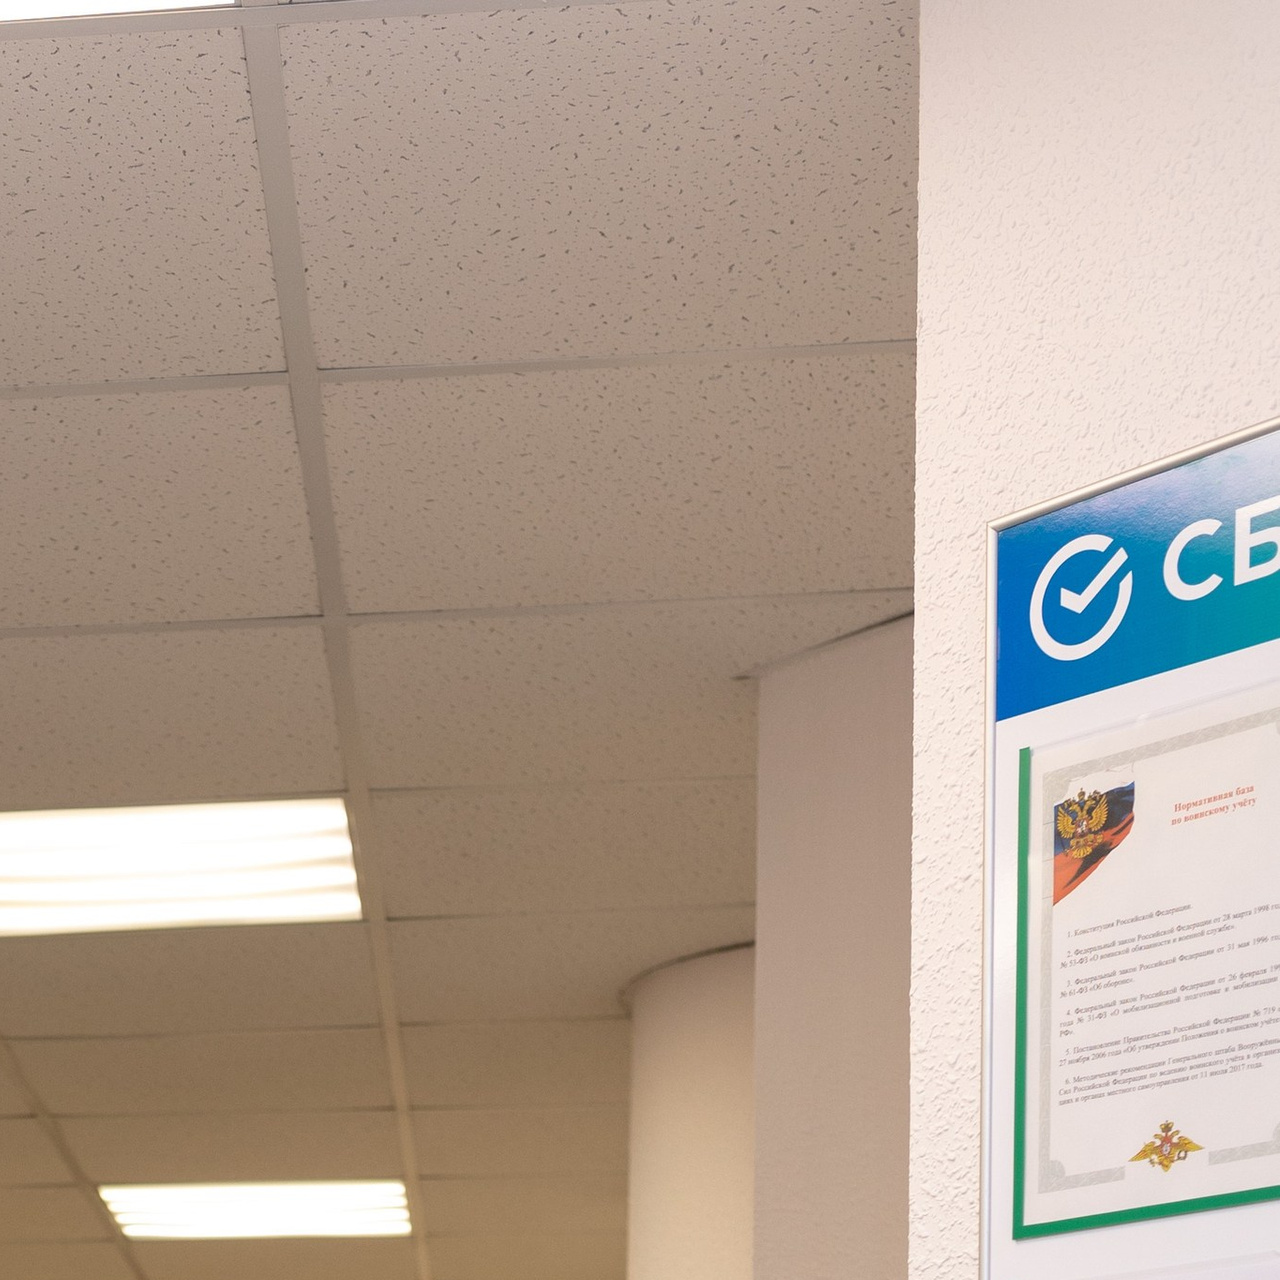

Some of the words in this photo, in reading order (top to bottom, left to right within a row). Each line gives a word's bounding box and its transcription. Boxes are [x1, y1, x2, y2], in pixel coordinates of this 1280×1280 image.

[1174, 791, 1233, 812] Нормативная
[1236, 786, 1254, 795] база
[1184, 804, 1230, 822] воинскому
